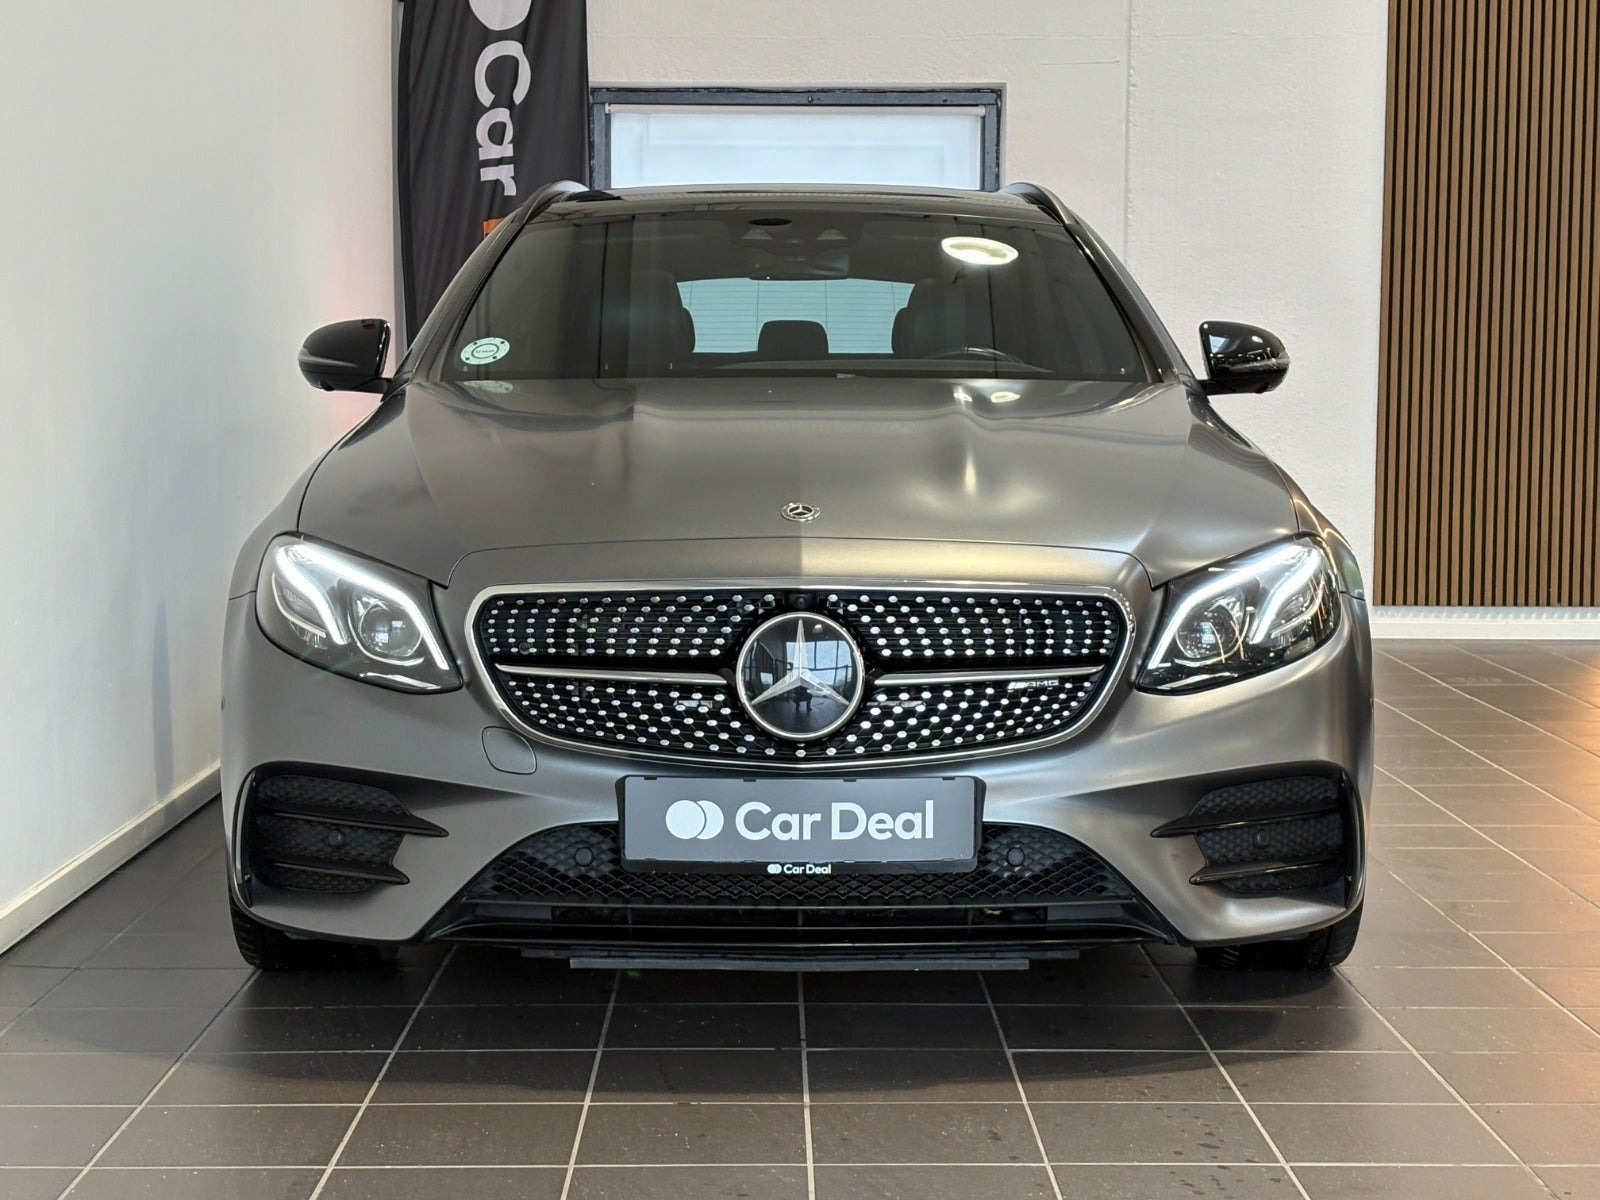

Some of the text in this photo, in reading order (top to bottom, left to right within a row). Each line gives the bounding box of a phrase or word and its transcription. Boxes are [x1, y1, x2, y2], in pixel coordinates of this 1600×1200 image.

[474, 40, 531, 196] Car
[735, 800, 934, 841] Car Deal
[783, 863, 832, 874] Car Deal
